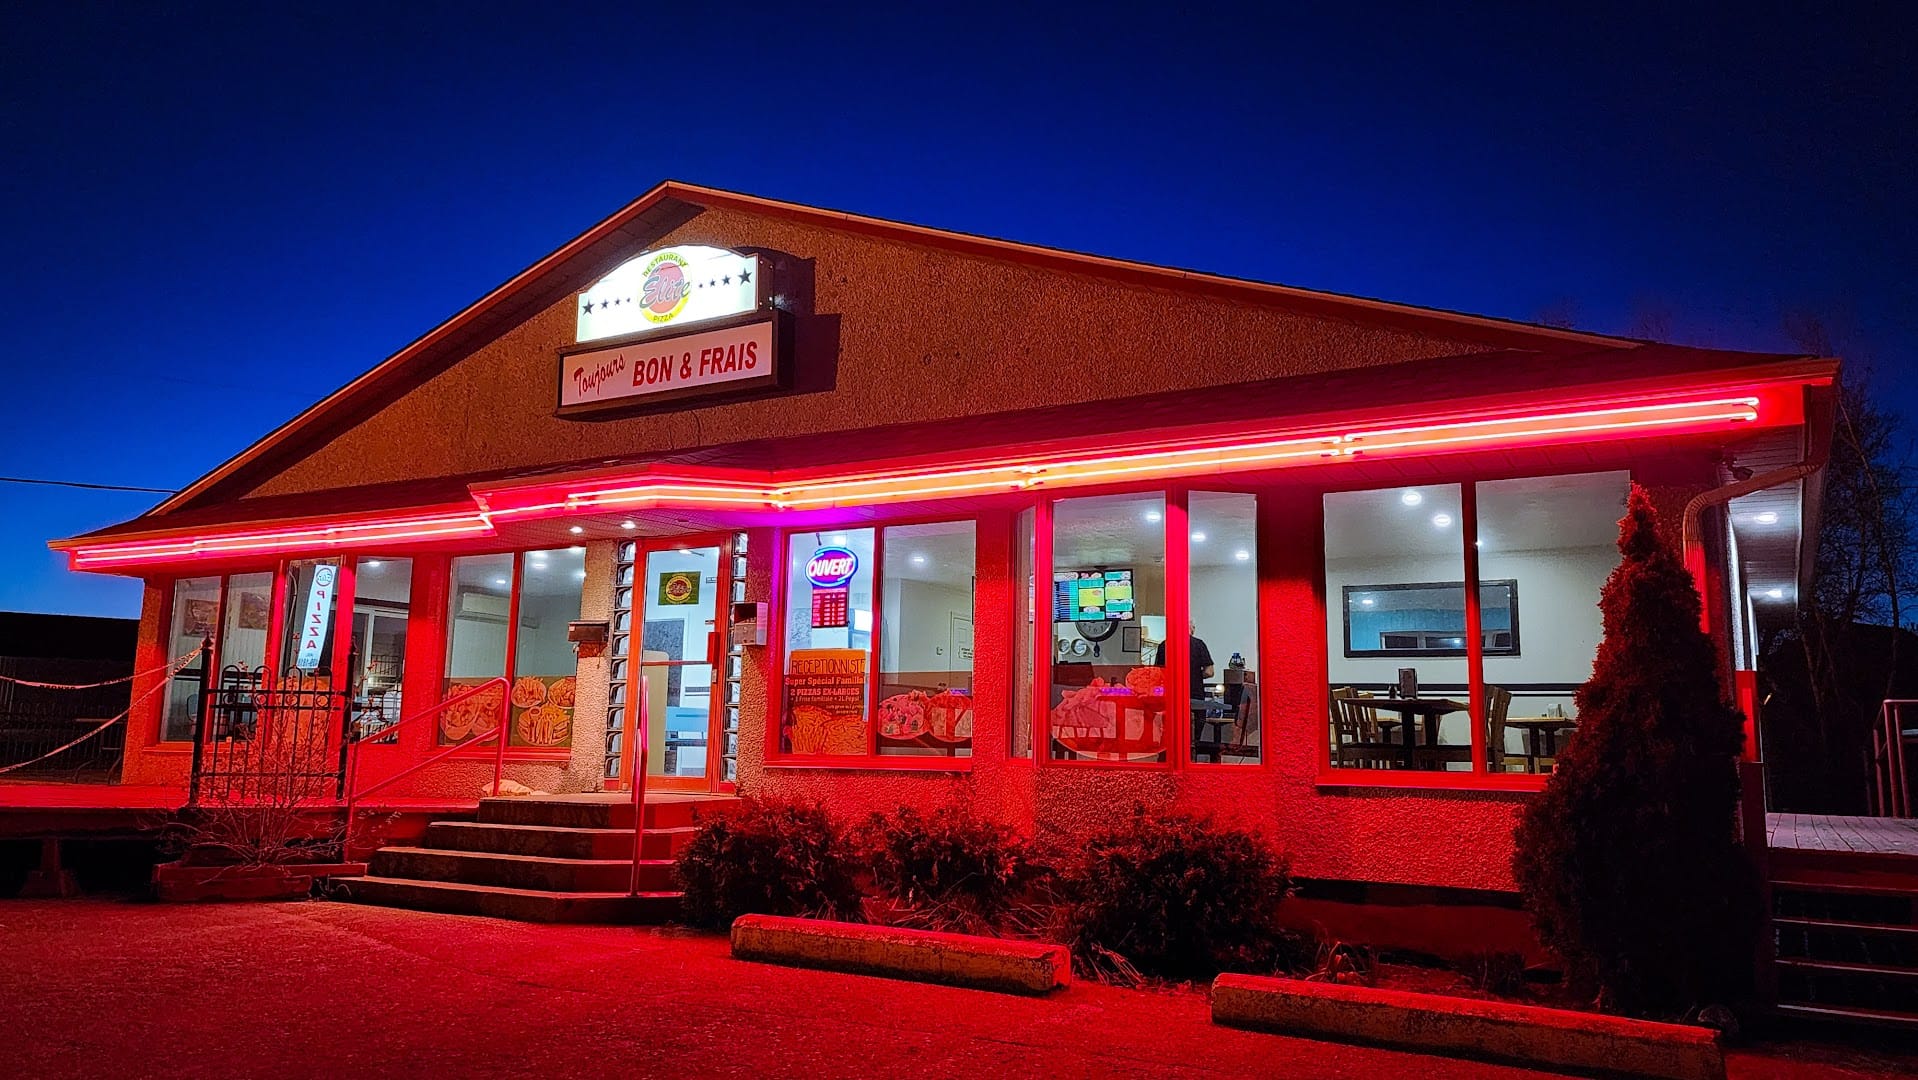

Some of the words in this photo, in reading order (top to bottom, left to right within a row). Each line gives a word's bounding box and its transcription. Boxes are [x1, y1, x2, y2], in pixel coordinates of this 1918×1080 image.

[643, 253, 689, 277] RESTAURANT
[653, 312, 674, 322] PIZZA
[574, 354, 625, 396] Toujours
[632, 355, 674, 387] BON
[679, 352, 692, 379] &
[699, 341, 758, 376] FRAIS
[808, 558, 853, 576] OUVERT
[785, 677, 806, 687] Super
[797, 688, 821, 696] PIZZAS
[823, 687, 860, 696] EX-LARGES
